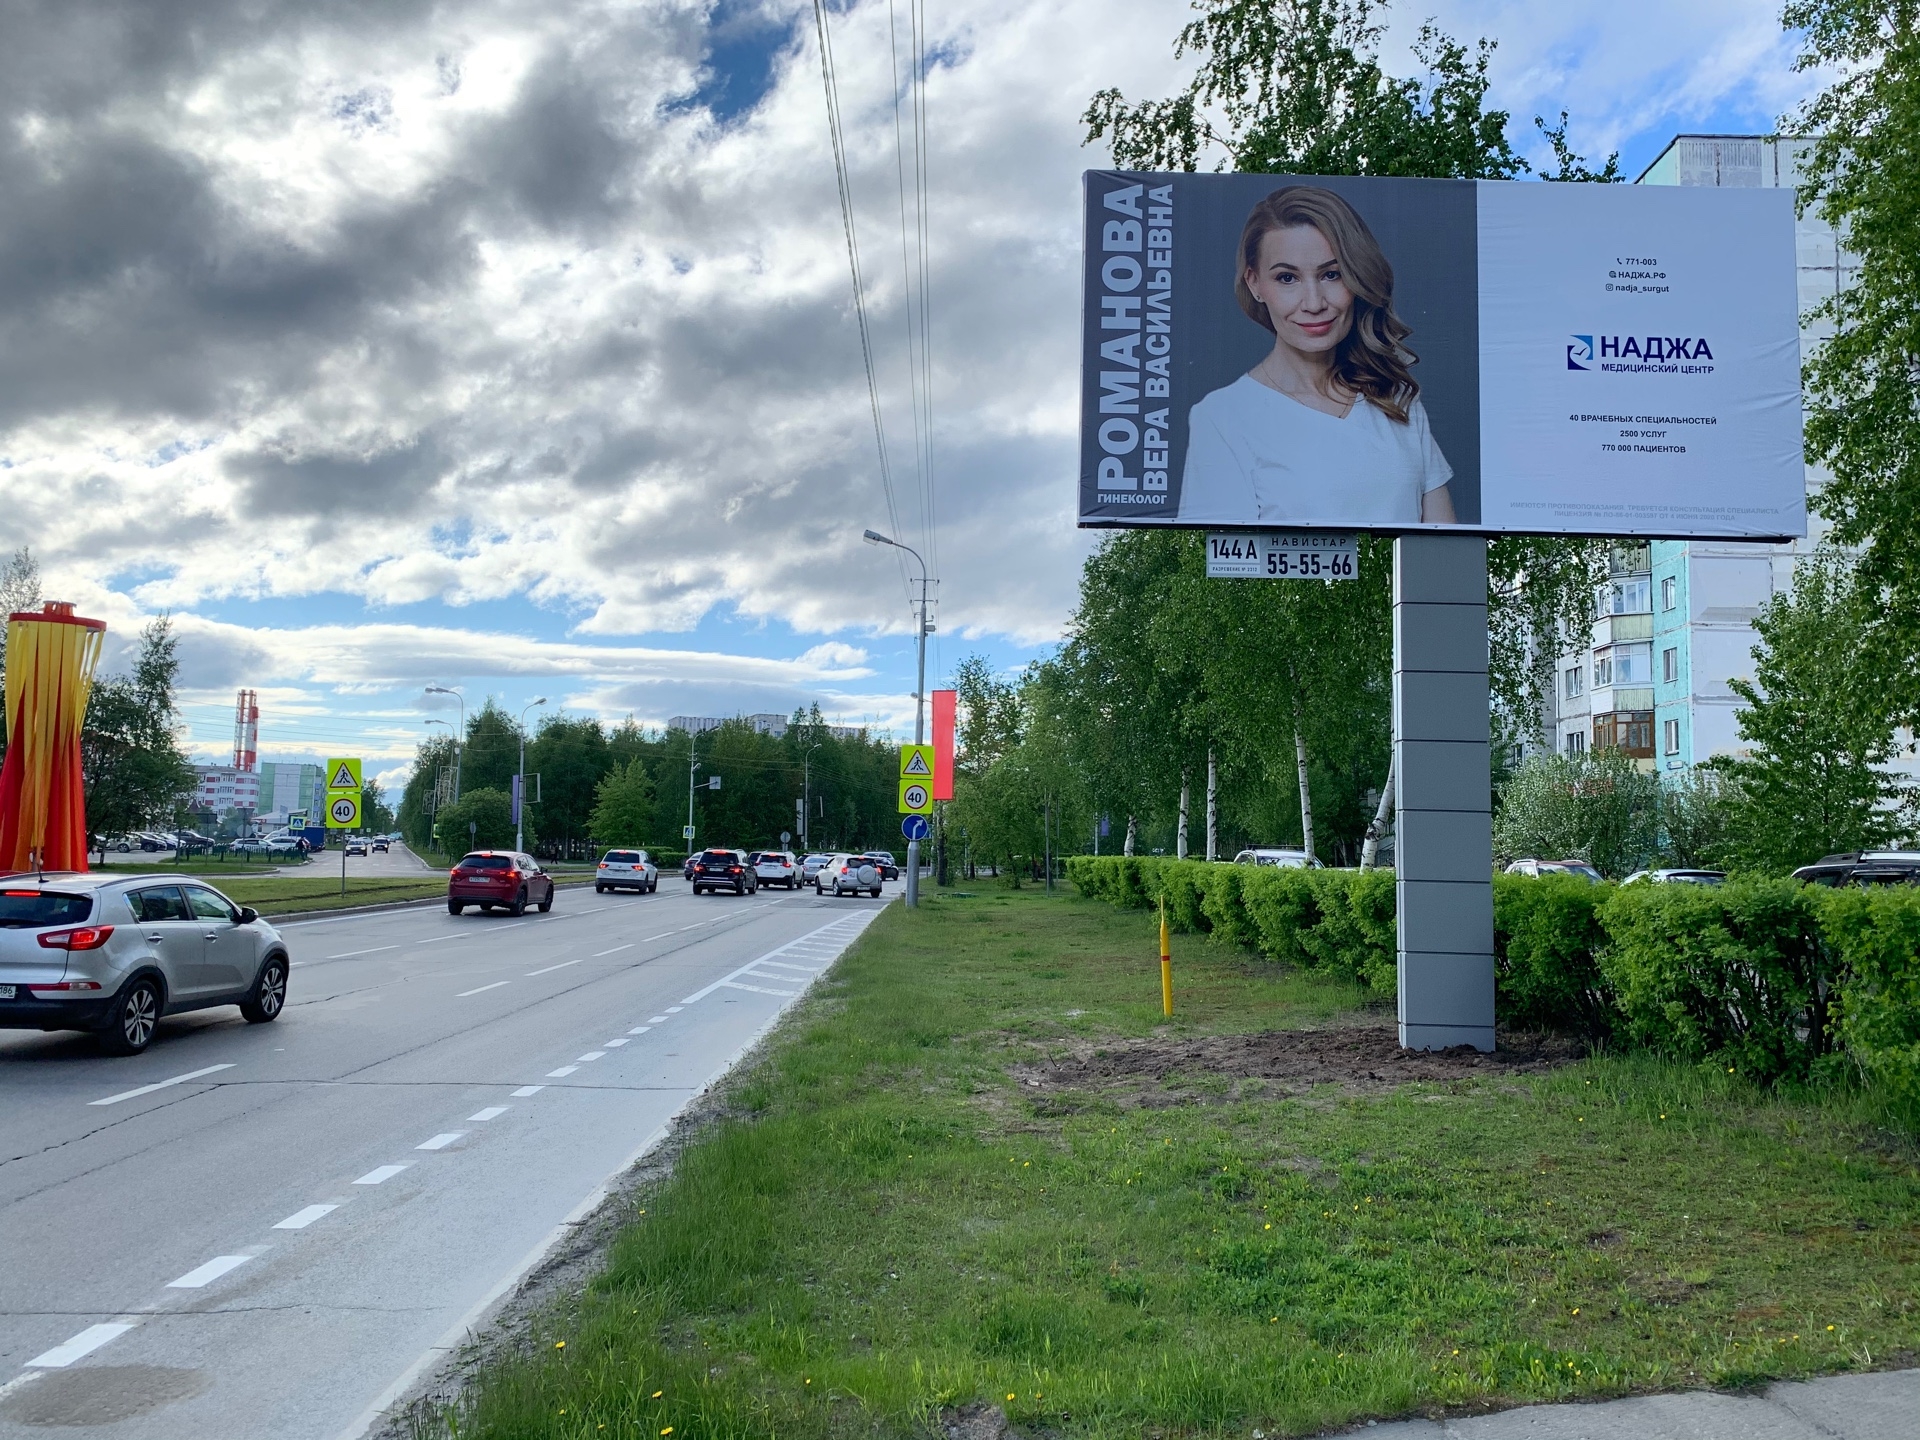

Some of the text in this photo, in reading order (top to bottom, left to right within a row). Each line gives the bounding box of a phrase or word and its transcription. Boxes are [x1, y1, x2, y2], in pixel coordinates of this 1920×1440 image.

[1625, 258, 1657, 266] 771-003
[1618, 271, 1667, 280] НАДЖА.РФ
[1615, 284, 1670, 294] nadja_surgut
[1098, 184, 1143, 491] РОМАНОВА
[1143, 184, 1173, 491] ВЕРА ВАСИЛЬЕВНА
[1601, 335, 1714, 364] НАДЖА
[1601, 363, 1715, 375] МЕДИЦИНСКИЙ ЦЕНТР
[1569, 414, 1717, 425] 40 ВРАЧЕБНЫХ СПЕЦИАЛЬНОСТЕЙ
[1620, 430, 1667, 439] 2500 УСЛУГ
[1602, 444, 1616, 452] 770
[1633, 445, 1686, 454] ПАЦИЕНТОВ
[1098, 493, 1168, 505] ГИНЕКОЛОГ
[1669, 506, 1726, 514] КОНСУЛЬТАЦИЯ
[1271, 537, 1346, 547] НАВИСТАР
[1267, 553, 1352, 575] 55-55-66
[908, 792, 922, 803] 40
[335, 806, 350, 816] 40
